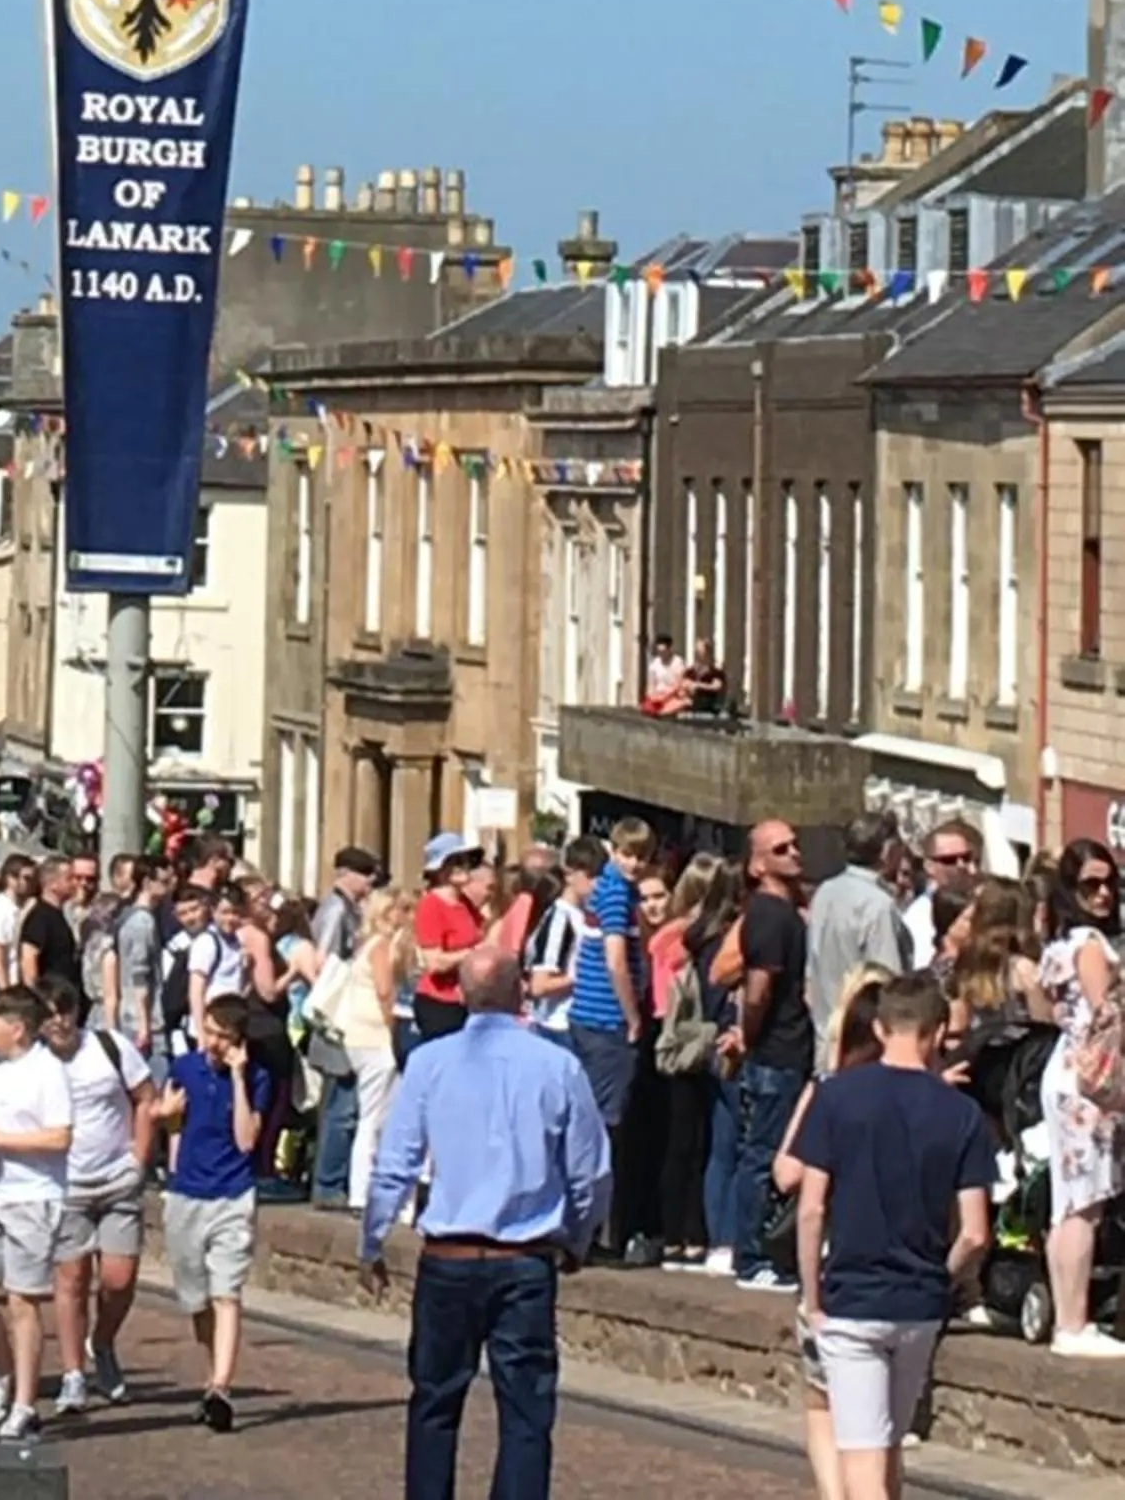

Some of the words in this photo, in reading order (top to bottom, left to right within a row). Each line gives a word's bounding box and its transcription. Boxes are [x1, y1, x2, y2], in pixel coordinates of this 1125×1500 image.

[80, 91, 205, 126] ROYAL
[76, 135, 208, 169] BURGH
[113, 179, 167, 210] OF
[66, 218, 212, 255] LANARK
[70, 268, 139, 301] 1140
[144, 273, 203, 303] A.D.
